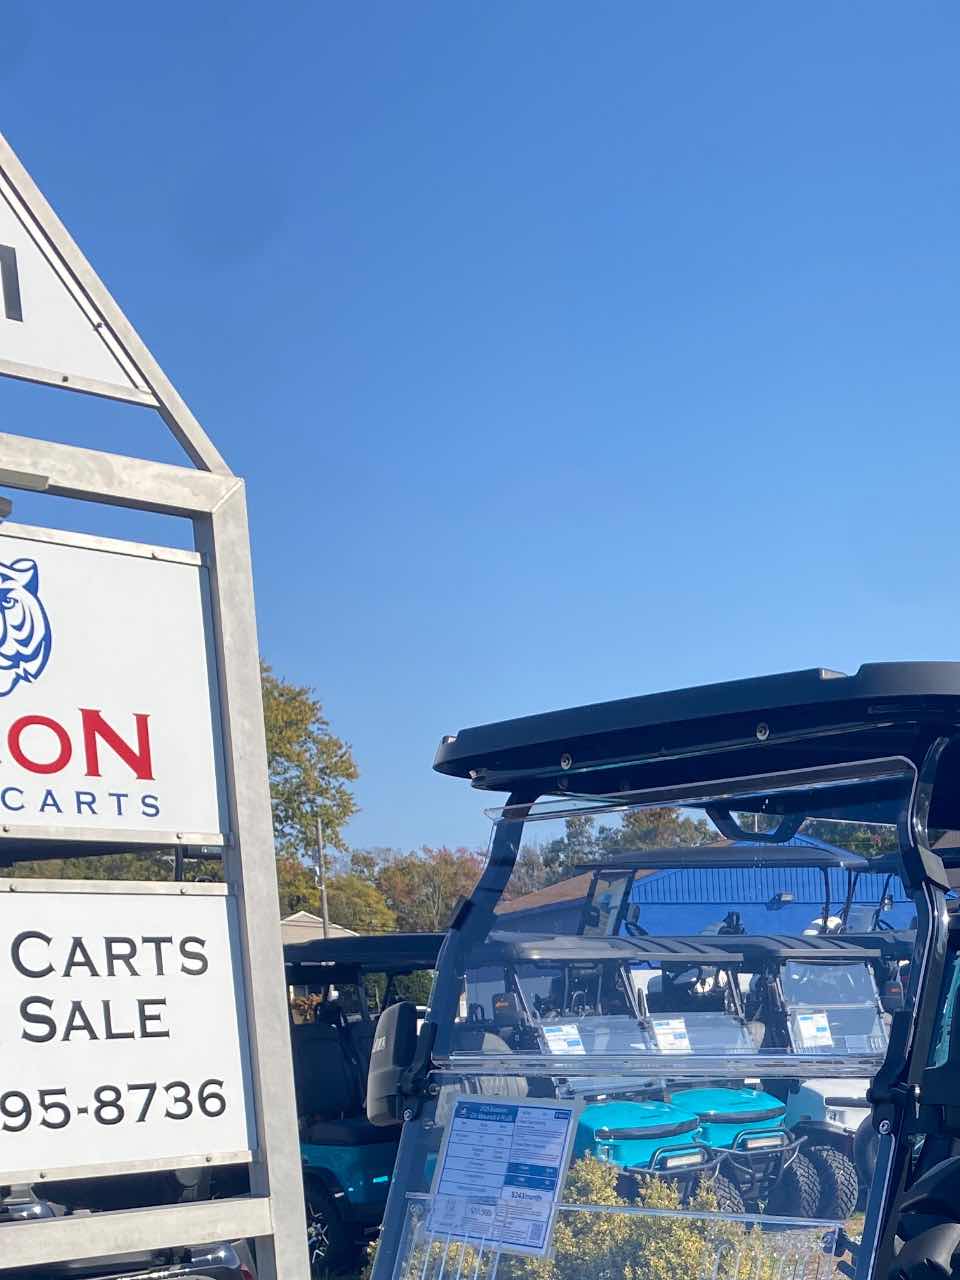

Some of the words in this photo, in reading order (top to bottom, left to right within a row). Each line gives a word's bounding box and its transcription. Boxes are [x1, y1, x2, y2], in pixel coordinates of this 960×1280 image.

[0, 786, 160, 818] CARTS
[11, 930, 209, 978] CARTS
[19, 995, 170, 1043] SALE
[0, 1078, 227, 1132] 95-8736
